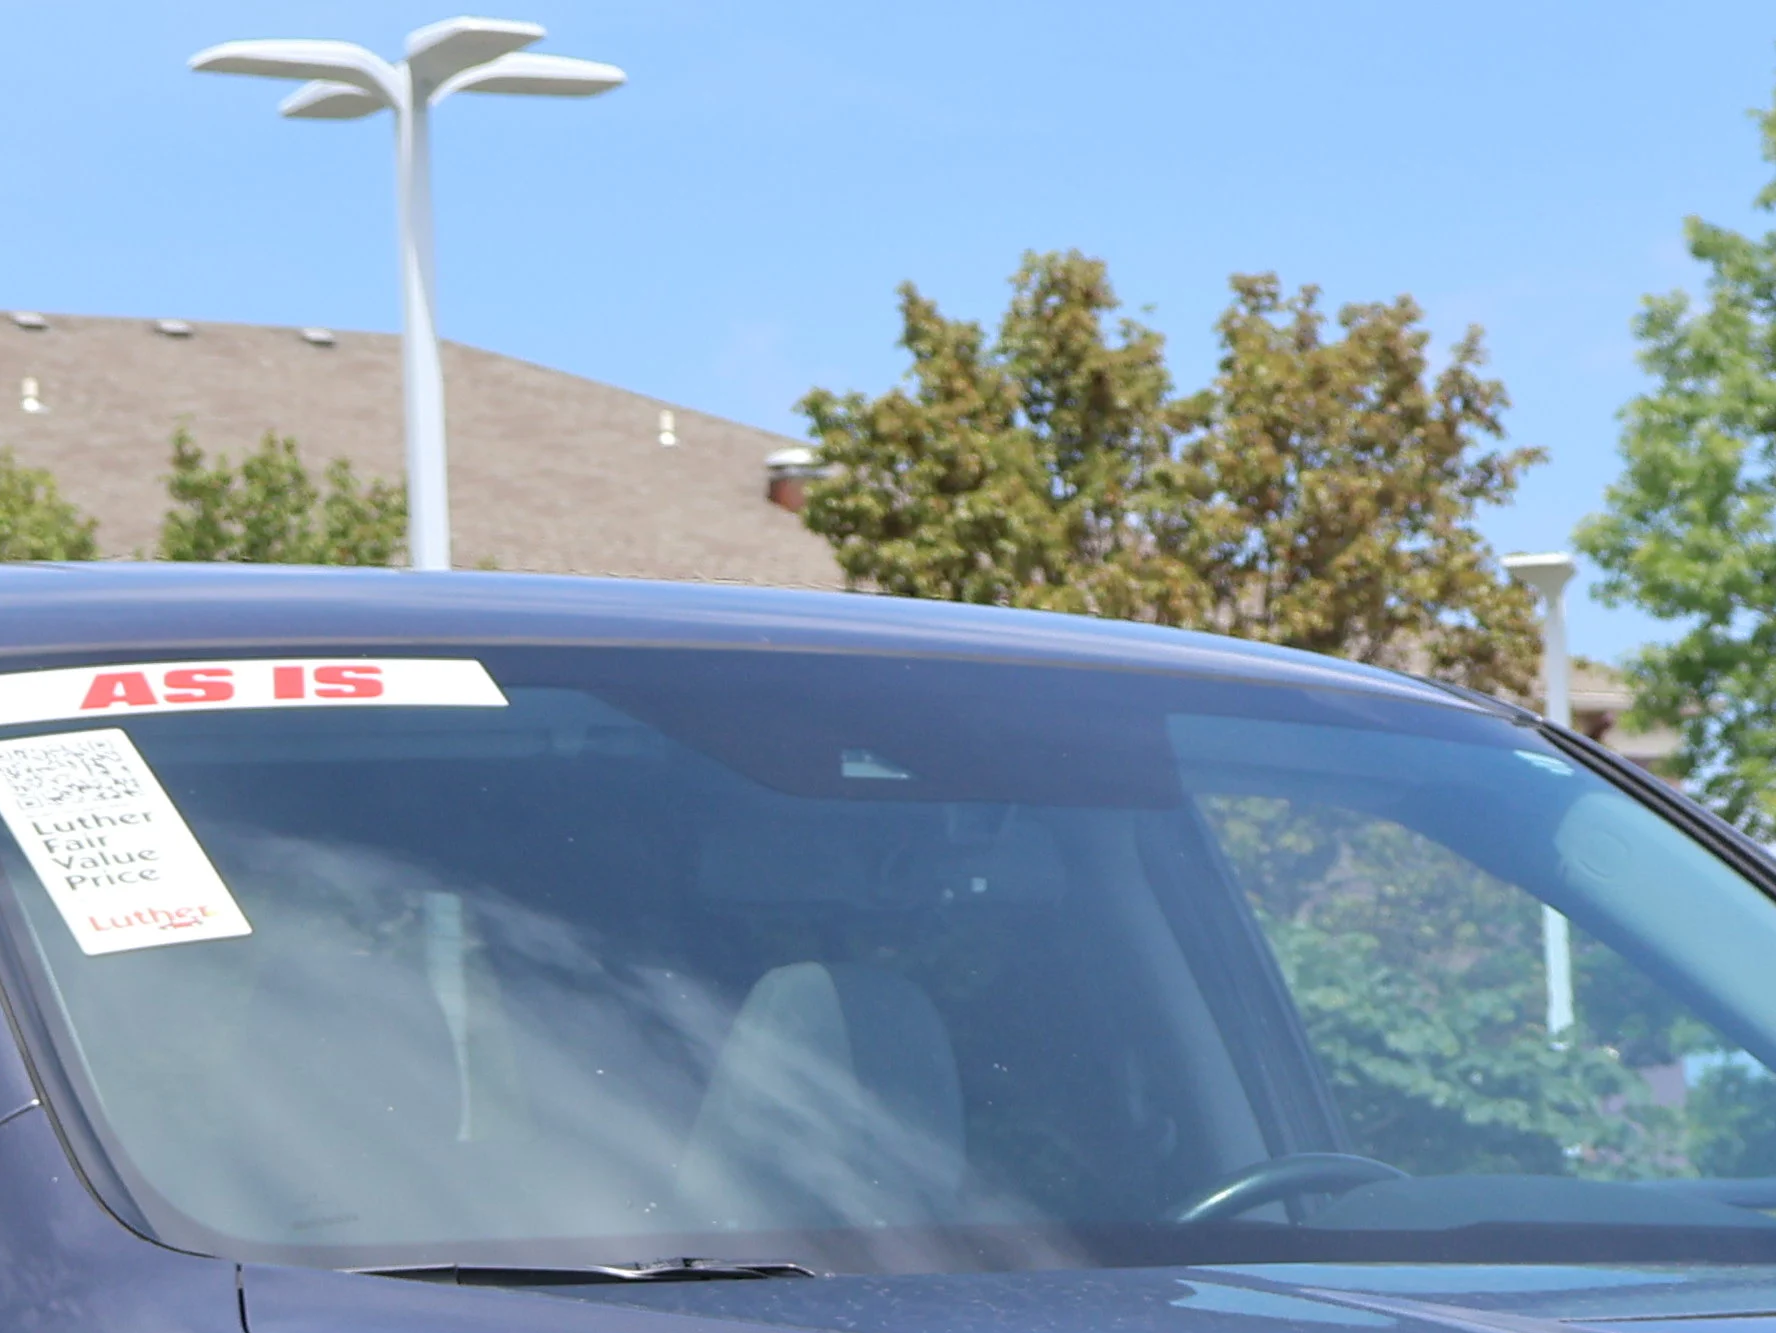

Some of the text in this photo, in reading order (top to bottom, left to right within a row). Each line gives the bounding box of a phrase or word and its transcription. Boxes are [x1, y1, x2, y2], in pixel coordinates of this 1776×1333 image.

[80, 665, 384, 710] AS IS
[31, 811, 153, 836] Luther
[42, 835, 108, 854] Fair
[51, 849, 160, 870] Value
[64, 868, 161, 891] Price
[88, 905, 210, 932] Luther
